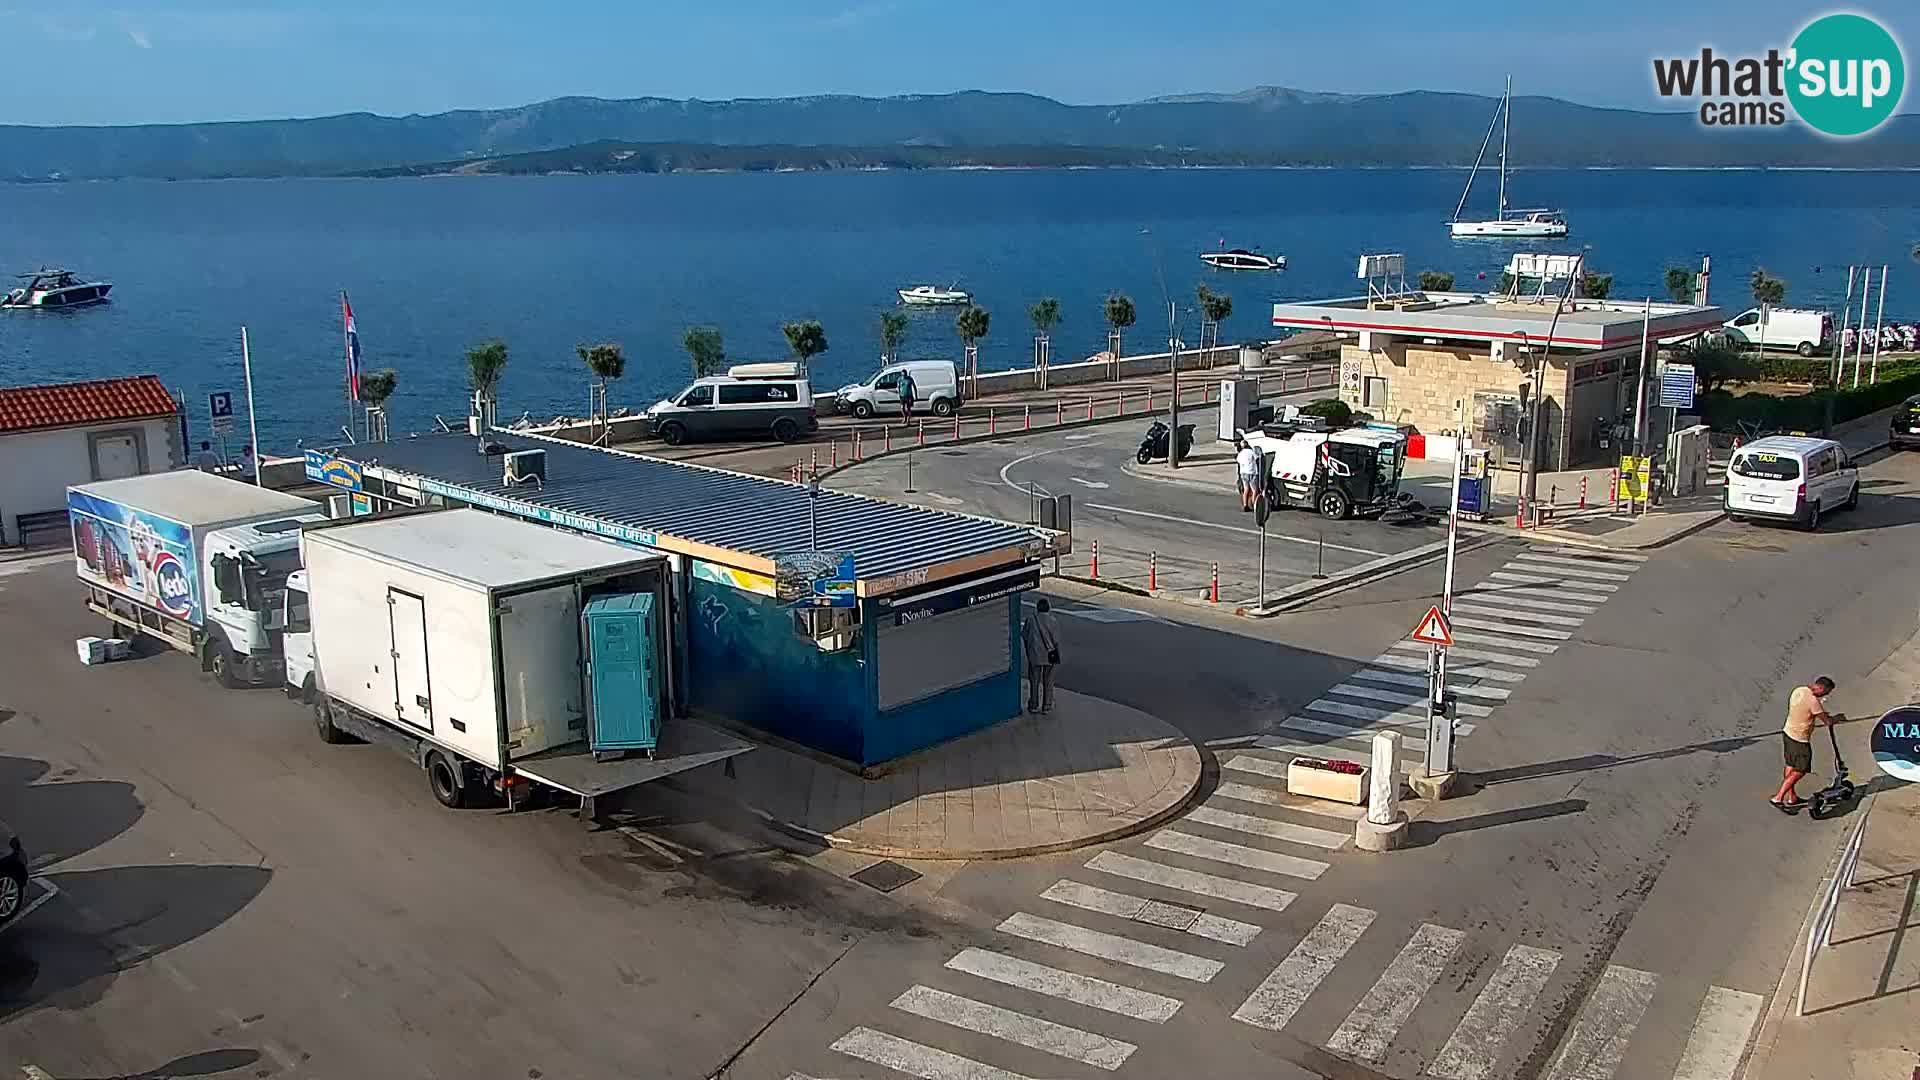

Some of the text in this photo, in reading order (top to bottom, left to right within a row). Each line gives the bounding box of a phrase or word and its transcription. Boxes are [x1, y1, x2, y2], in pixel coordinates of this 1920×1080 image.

[215, 396, 226, 413] P
[1759, 454, 1777, 463] TAXI
[509, 500, 540, 518] POSTAJA
[550, 511, 565, 524] BUS
[565, 514, 597, 534] STATION
[600, 522, 624, 538] TICKET
[625, 529, 653, 545] OFFICE
[901, 607, 934, 625] Novine
